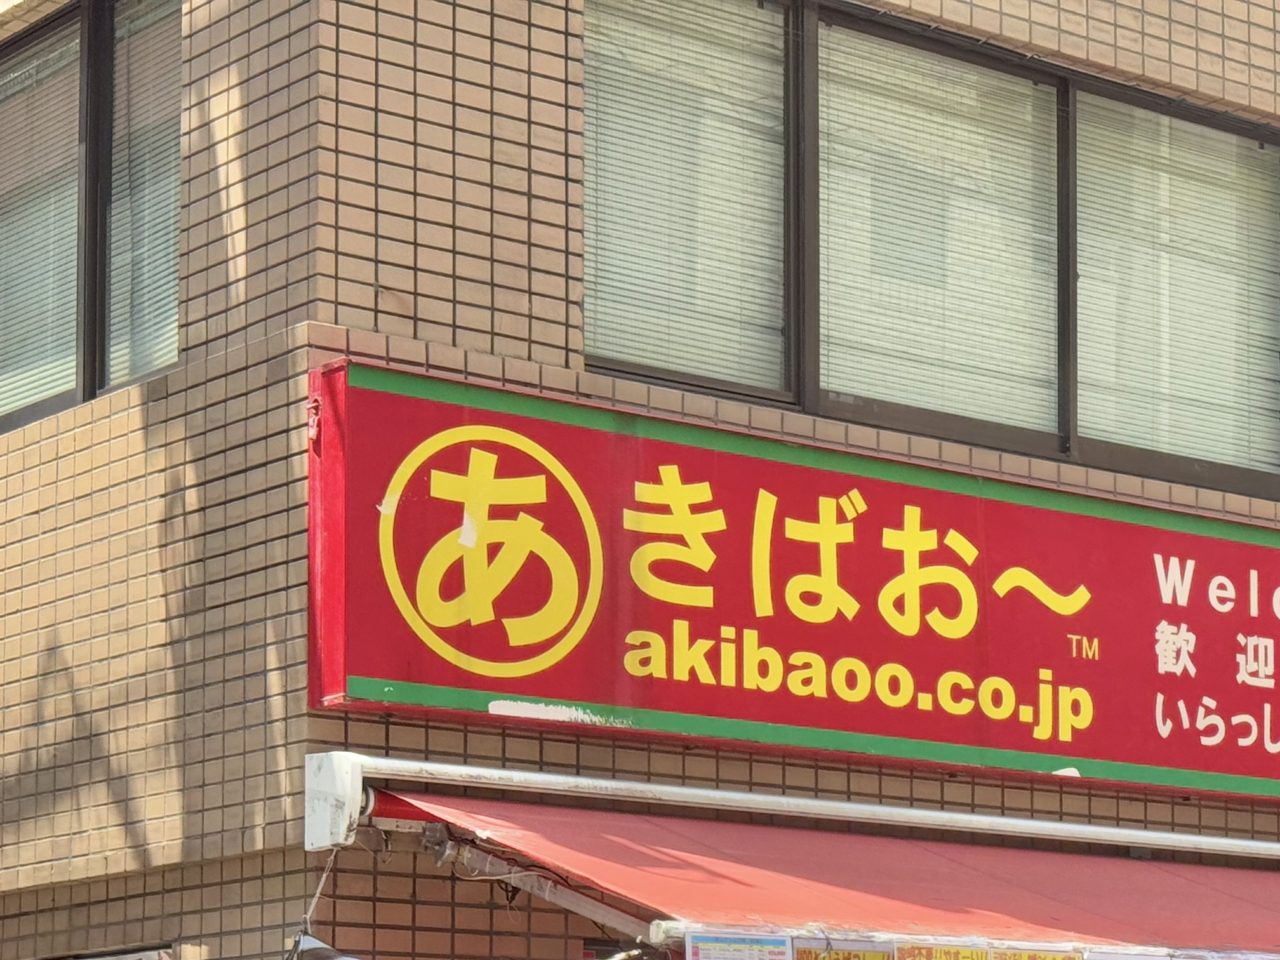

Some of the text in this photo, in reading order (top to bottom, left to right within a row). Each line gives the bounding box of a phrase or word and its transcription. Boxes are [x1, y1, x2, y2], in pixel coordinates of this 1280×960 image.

[623, 464, 1091, 639] きばお〜
[623, 619, 1094, 742] akibaoo.co.jp
[1067, 634, 1099, 660] TM
